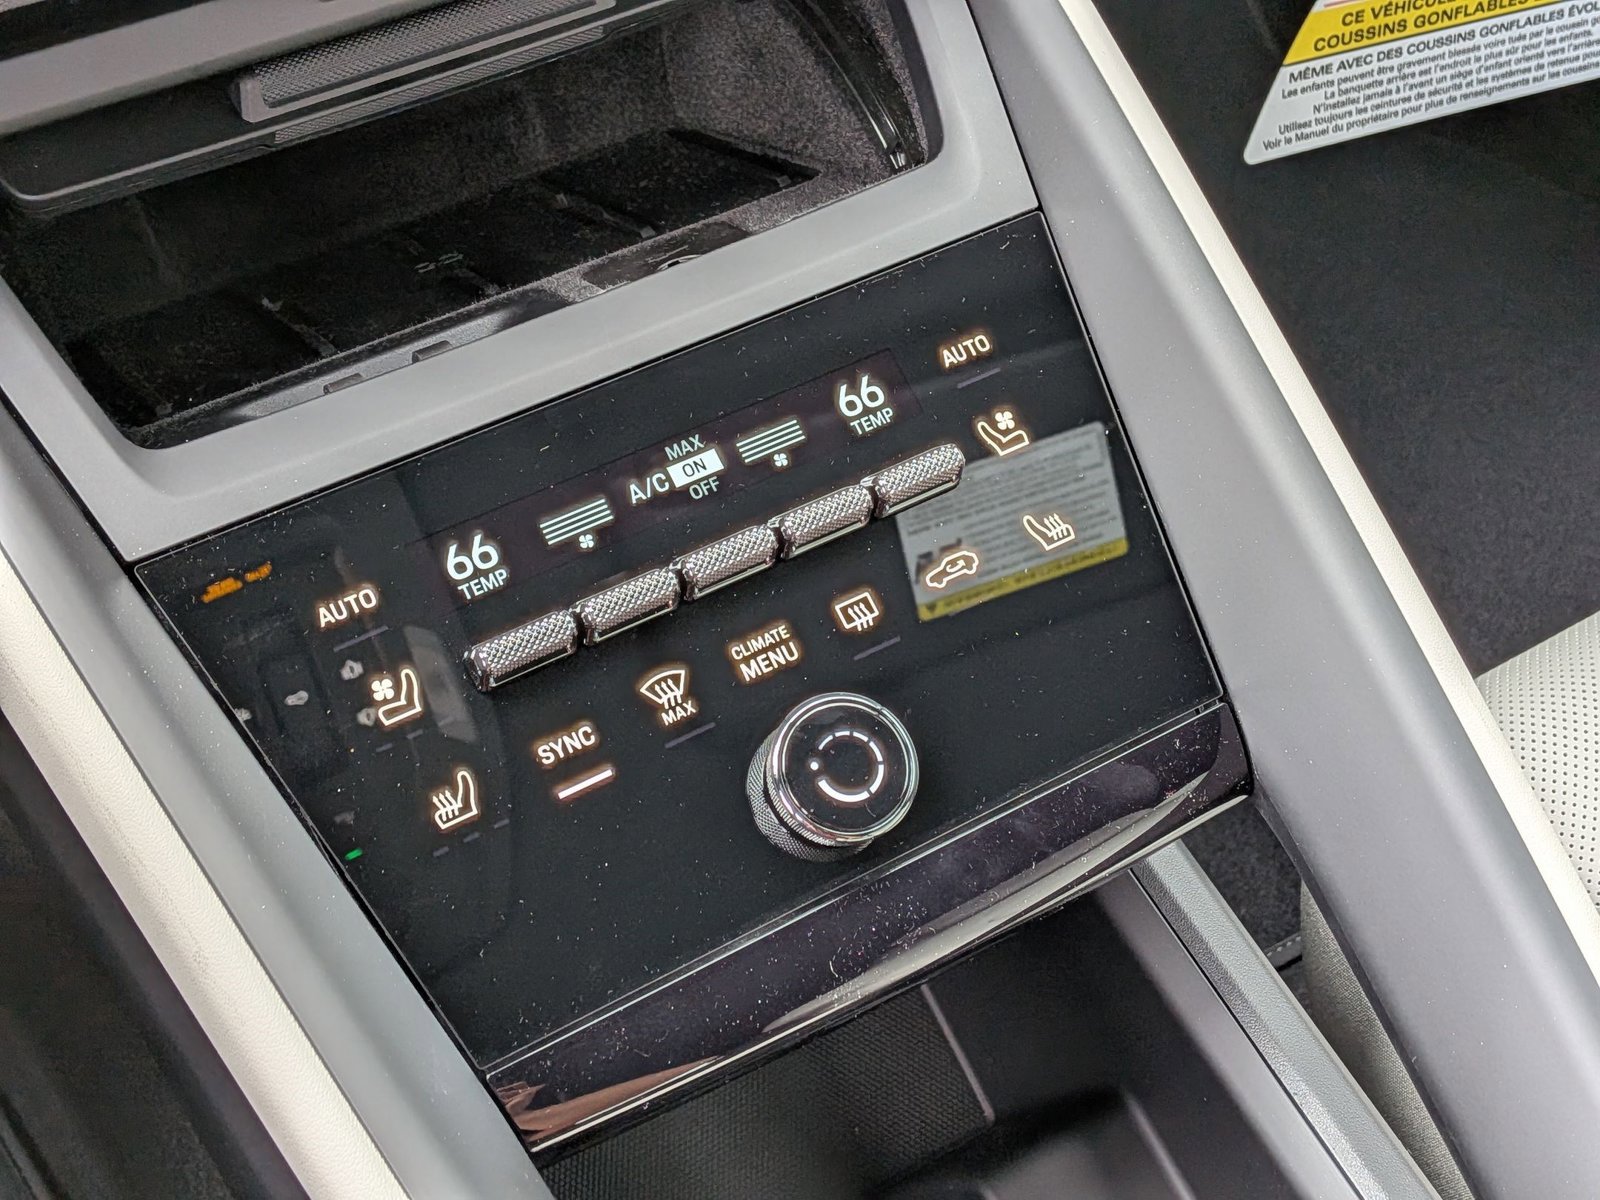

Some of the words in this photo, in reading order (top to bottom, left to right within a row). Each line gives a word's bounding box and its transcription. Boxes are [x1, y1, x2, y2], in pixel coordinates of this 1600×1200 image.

[1341, 8, 1365, 27] CE
[1371, 0, 1456, 20] VÉHICU
[1289, 62, 1333, 83] MÊME
[1335, 53, 1373, 72] AVEC
[1376, 46, 1402, 62] DES
[1407, 28, 1475, 55] COUSSINS
[1479, 7, 1563, 38] GONFLABLES
[1314, 17, 1406, 53] COUSSINS
[1281, 88, 1297, 99] Les
[1300, 79, 1334, 94] enfants
[1337, 69, 1374, 88] peuvent
[1397, 52, 1445, 73] gravement
[1483, 38, 1505, 50] voire
[1528, 29, 1543, 42] par
[1546, 26, 1553, 35] le
[1555, 18, 1588, 33] coussin
[1324, 90, 1335, 100] La
[1338, 79, 1383, 96] banquette
[1418, 66, 1432, 77] est
[1473, 55, 1481, 64] le
[1484, 50, 1502, 63] plus
[1521, 41, 1542, 54] pour
[1544, 37, 1556, 47] les
[1362, 88, 1392, 104] jamais
[1435, 75, 1446, 84] un
[1546, 47, 1565, 57] vers
[1263, 139, 1281, 150] Voir
[1283, 135, 1292, 145] le
[1294, 125, 1328, 142] Manuel
[1331, 123, 1343, 133] du
[1401, 105, 1422, 118] pour
[1424, 100, 1443, 112] plus
[1446, 96, 1457, 105] de
[1532, 75, 1546, 84] sur
[1547, 71, 1560, 80] les
[1278, 120, 1312, 134] Utilisez
[1314, 110, 1352, 125] toujours
[1354, 106, 1368, 115] les
[1370, 95, 1412, 112] ceintures
[1413, 91, 1425, 101] de
[1465, 80, 1474, 88] et
[1475, 77, 1488, 86] les
[1533, 62, 1544, 71] de
[1547, 55, 1580, 68] retenue
[943, 335, 990, 367] AUTO
[839, 374, 886, 418] 66
[850, 408, 894, 435] TEMP
[665, 434, 704, 460] MAX
[682, 456, 708, 476] ON
[630, 467, 670, 504] A/C
[689, 476, 720, 500] OFF
[446, 534, 499, 581] 66
[458, 568, 508, 600] TEMP
[319, 589, 376, 627] AUTO
[731, 624, 791, 660] CLIMATE
[740, 642, 799, 682] MENU
[661, 701, 697, 726] MAX
[538, 726, 595, 764] SYNC
